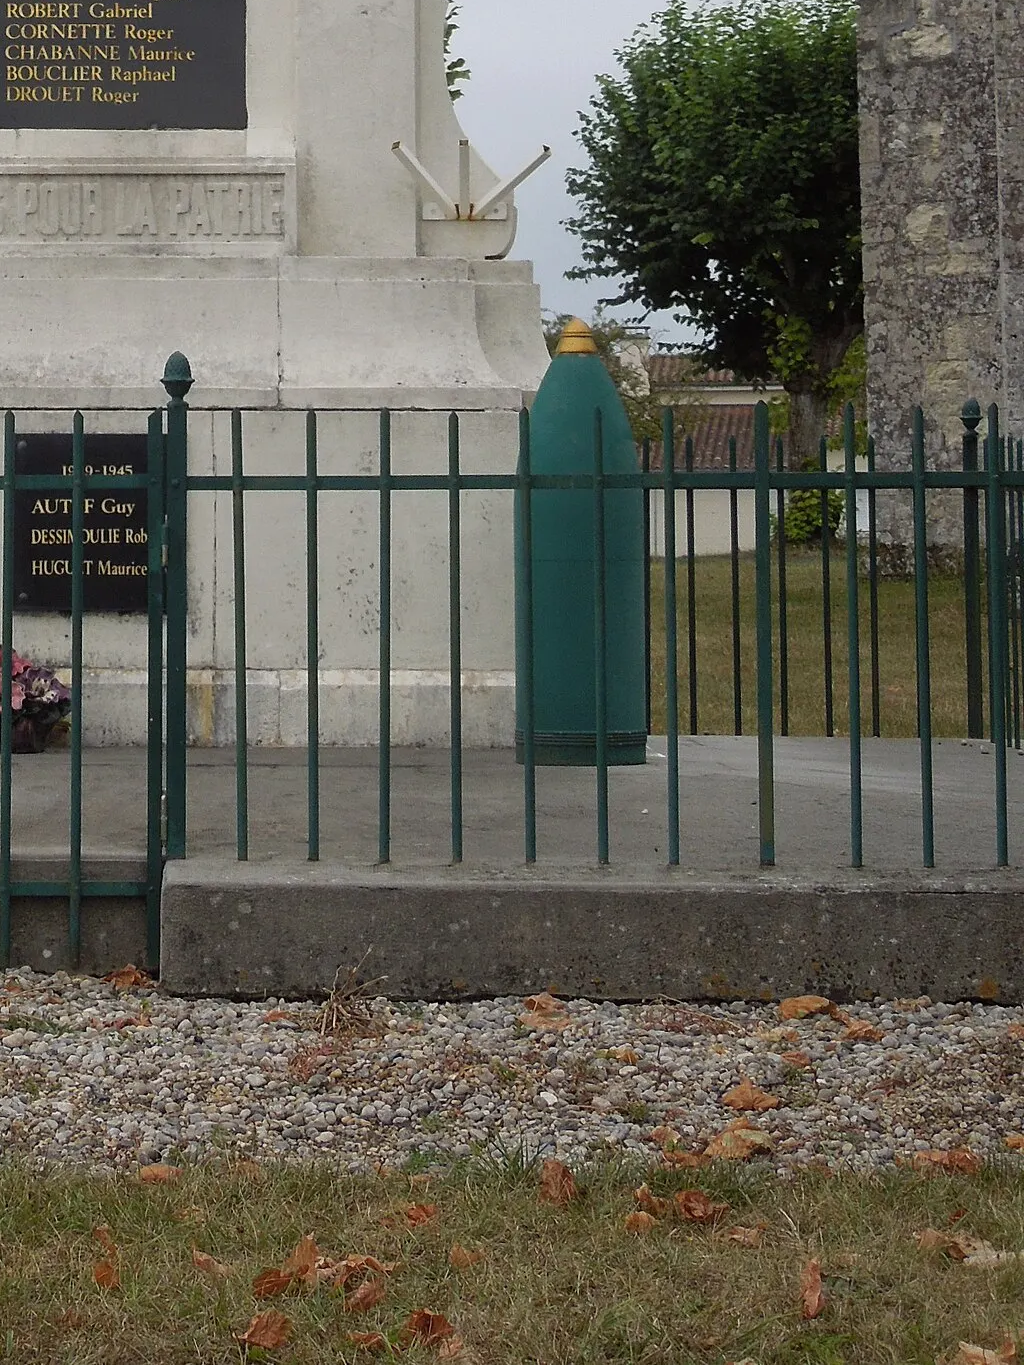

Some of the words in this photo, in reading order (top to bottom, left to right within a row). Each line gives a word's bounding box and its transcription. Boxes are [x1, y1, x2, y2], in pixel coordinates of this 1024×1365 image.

[7, 3, 83, 18] ROBERT
[89, 3, 152, 18] Gabriel
[6, 24, 116, 39] CORNETTE
[125, 24, 173, 43] Roger
[5, 45, 120, 60] CHABANNE
[129, 46, 195, 60] Maurice
[7, 66, 103, 81] BOUCLIER
[112, 66, 175, 85] Raphael
[7, 87, 85, 101] DROUET
[93, 87, 139, 103] Roger
[17, 181, 102, 236] POUR
[115, 181, 158, 236] LA
[170, 181, 283, 236] PATRIE
[62, 465, 133, 477] 199-1945
[31, 498, 95, 514] AUTF
[101, 498, 136, 517] Guy
[31, 559, 94, 576] HUGUT
[98, 560, 148, 576] Maurice
